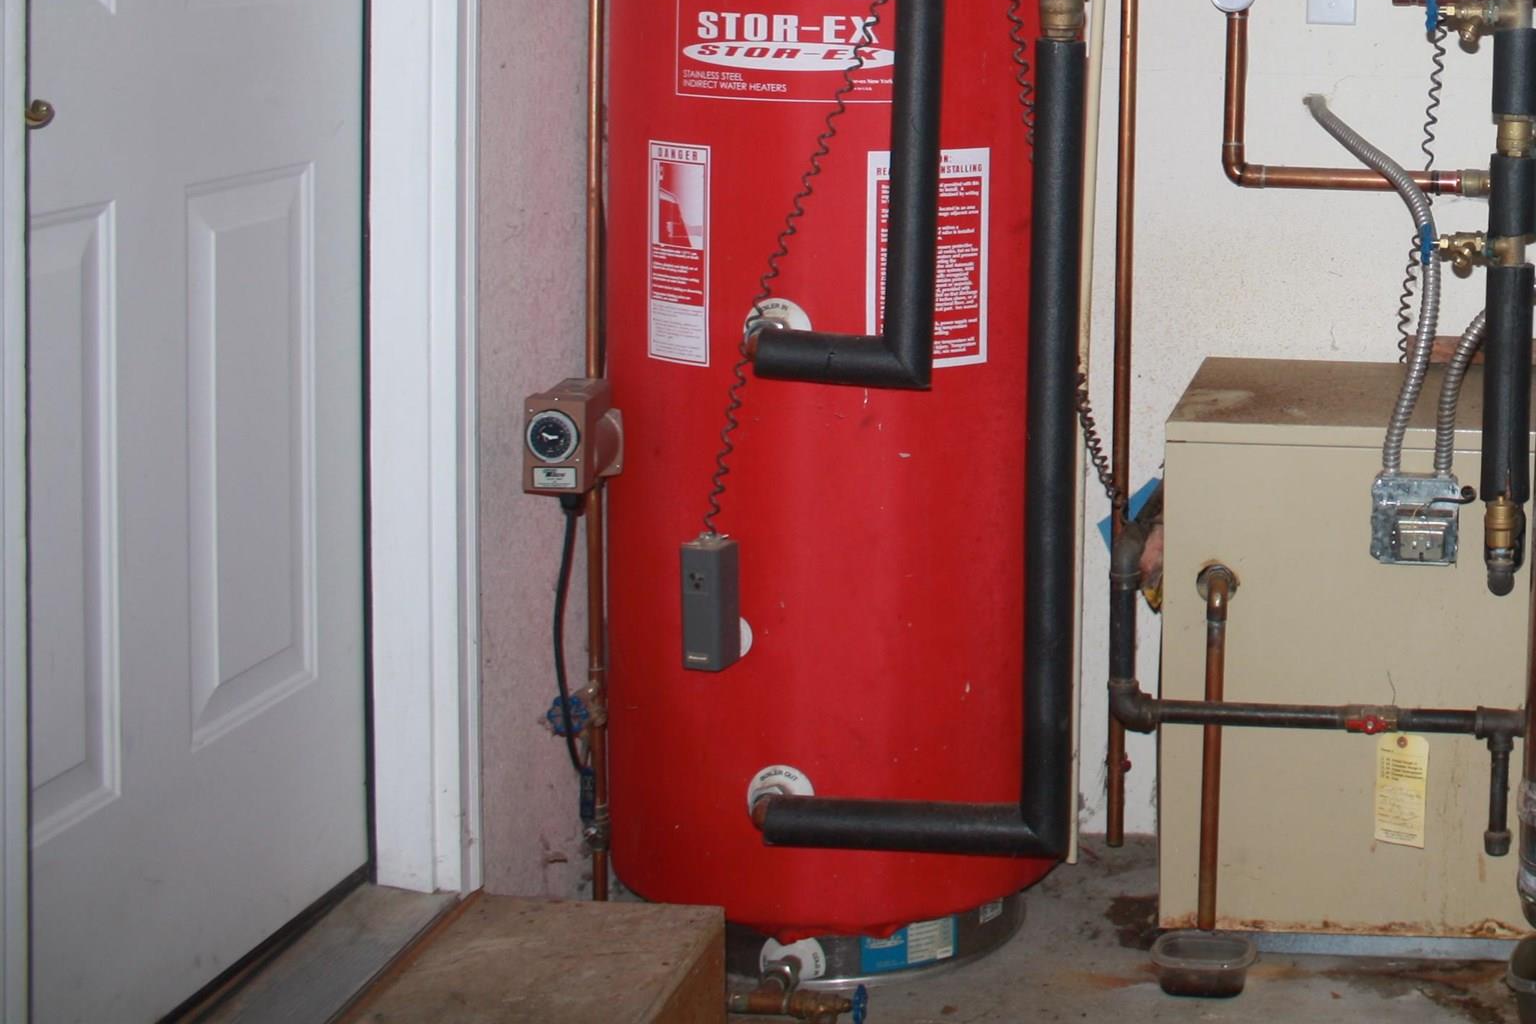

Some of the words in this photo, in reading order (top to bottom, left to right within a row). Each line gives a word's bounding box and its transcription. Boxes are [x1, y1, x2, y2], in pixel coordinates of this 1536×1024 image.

[697, 11, 879, 44] STOR-EX
[697, 44, 880, 60] STOR-EX
[683, 69, 720, 80] STAINLESS
[721, 72, 744, 81] STEEL
[683, 79, 718, 89] INDIRECT
[720, 81, 747, 91] WATER
[749, 83, 787, 93] HEATERS
[657, 147, 699, 161] DANGER
